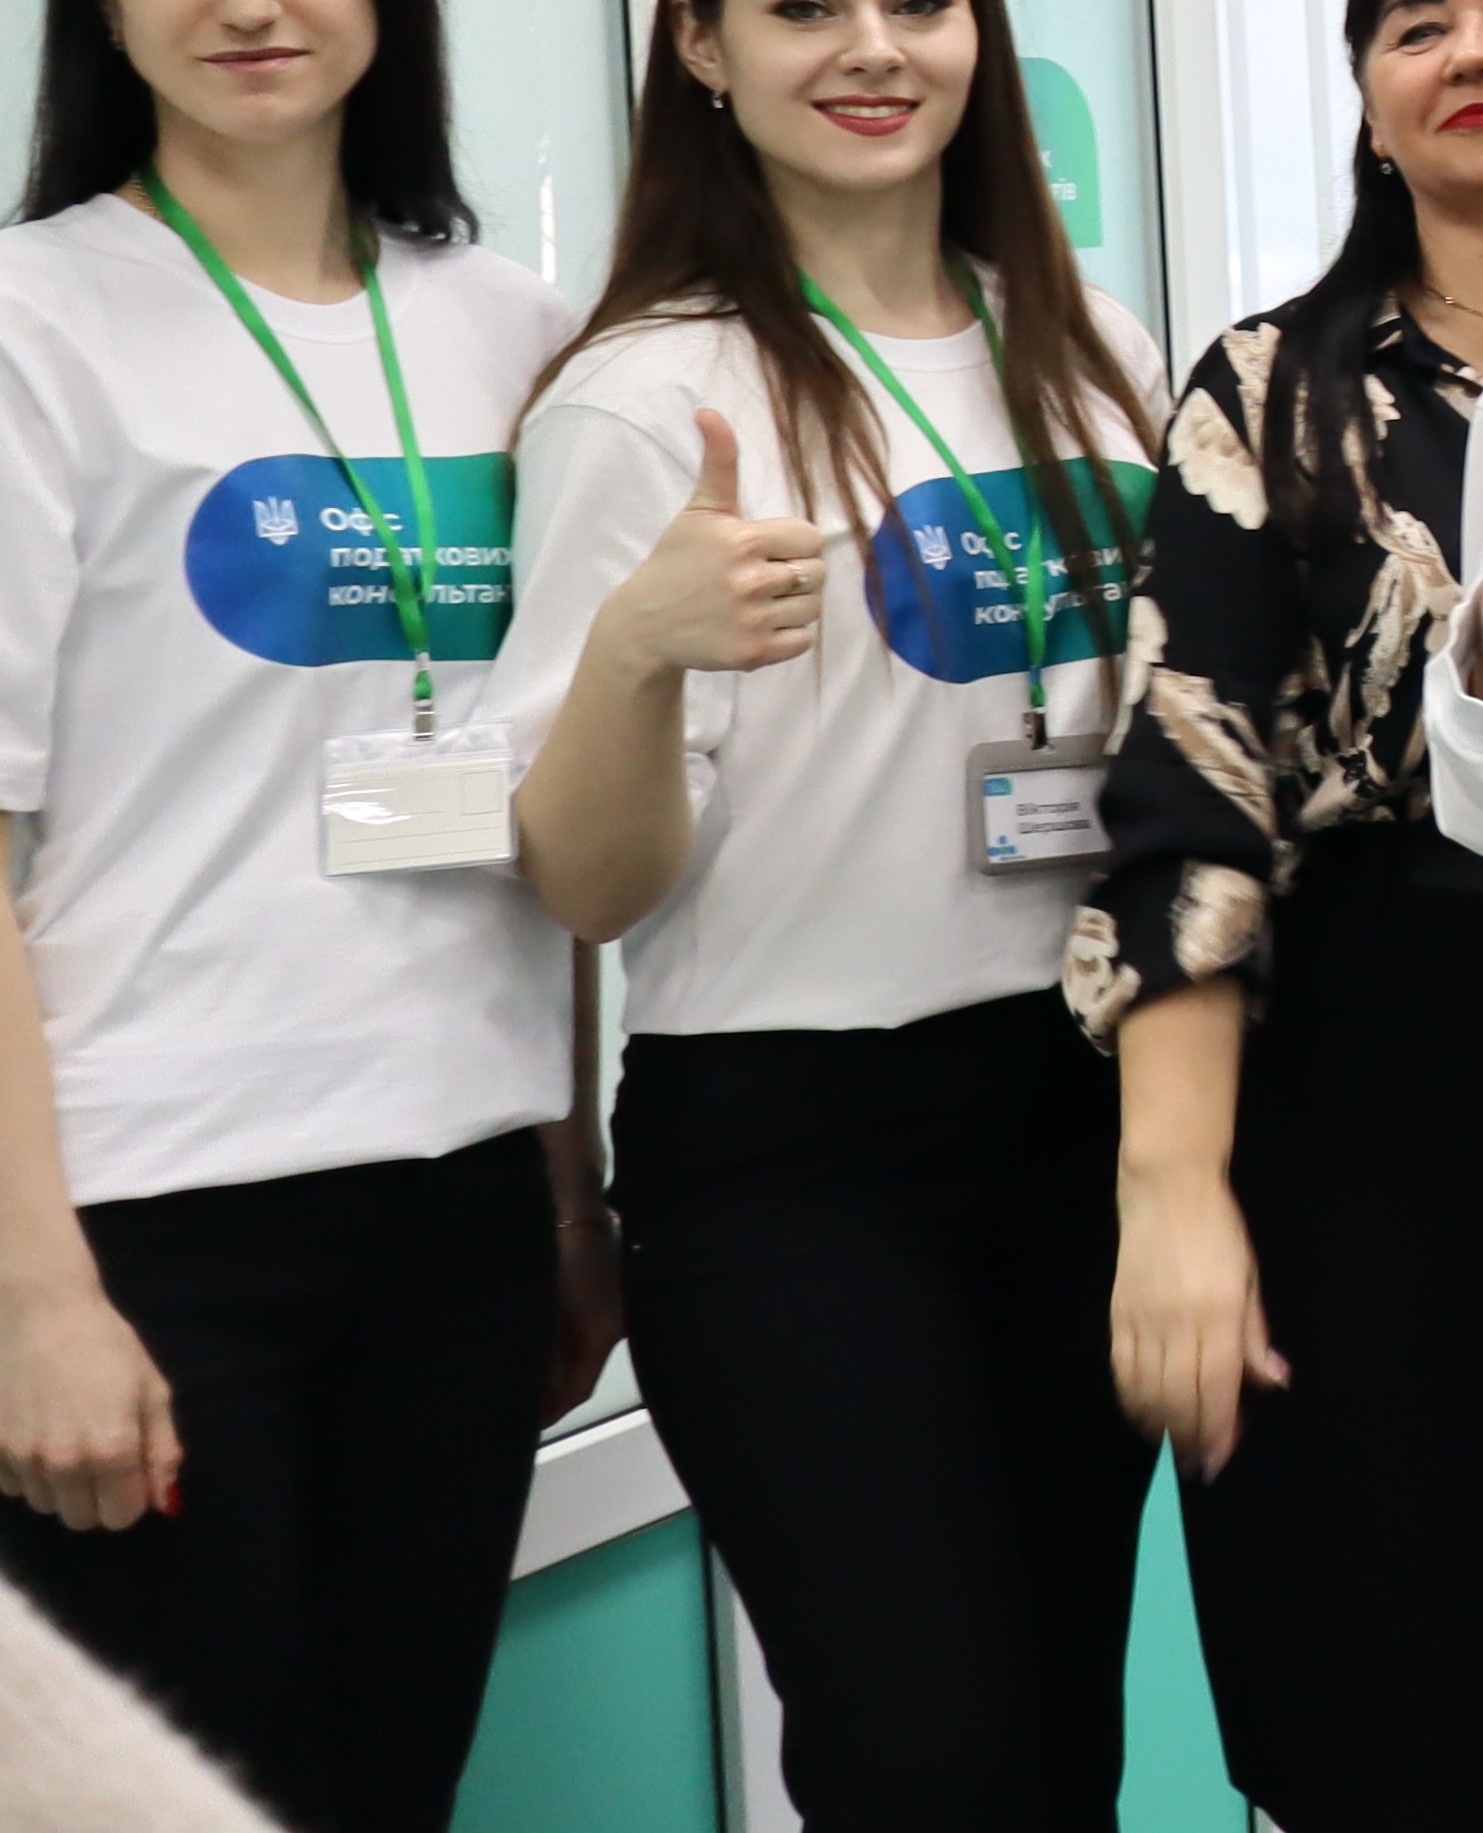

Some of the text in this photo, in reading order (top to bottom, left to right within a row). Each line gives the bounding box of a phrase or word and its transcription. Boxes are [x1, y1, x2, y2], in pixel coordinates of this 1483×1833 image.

[319, 506, 404, 536] Офс
[960, 531, 1023, 559] Офс
[330, 547, 512, 571] подтових
[328, 583, 512, 606] конльтан
